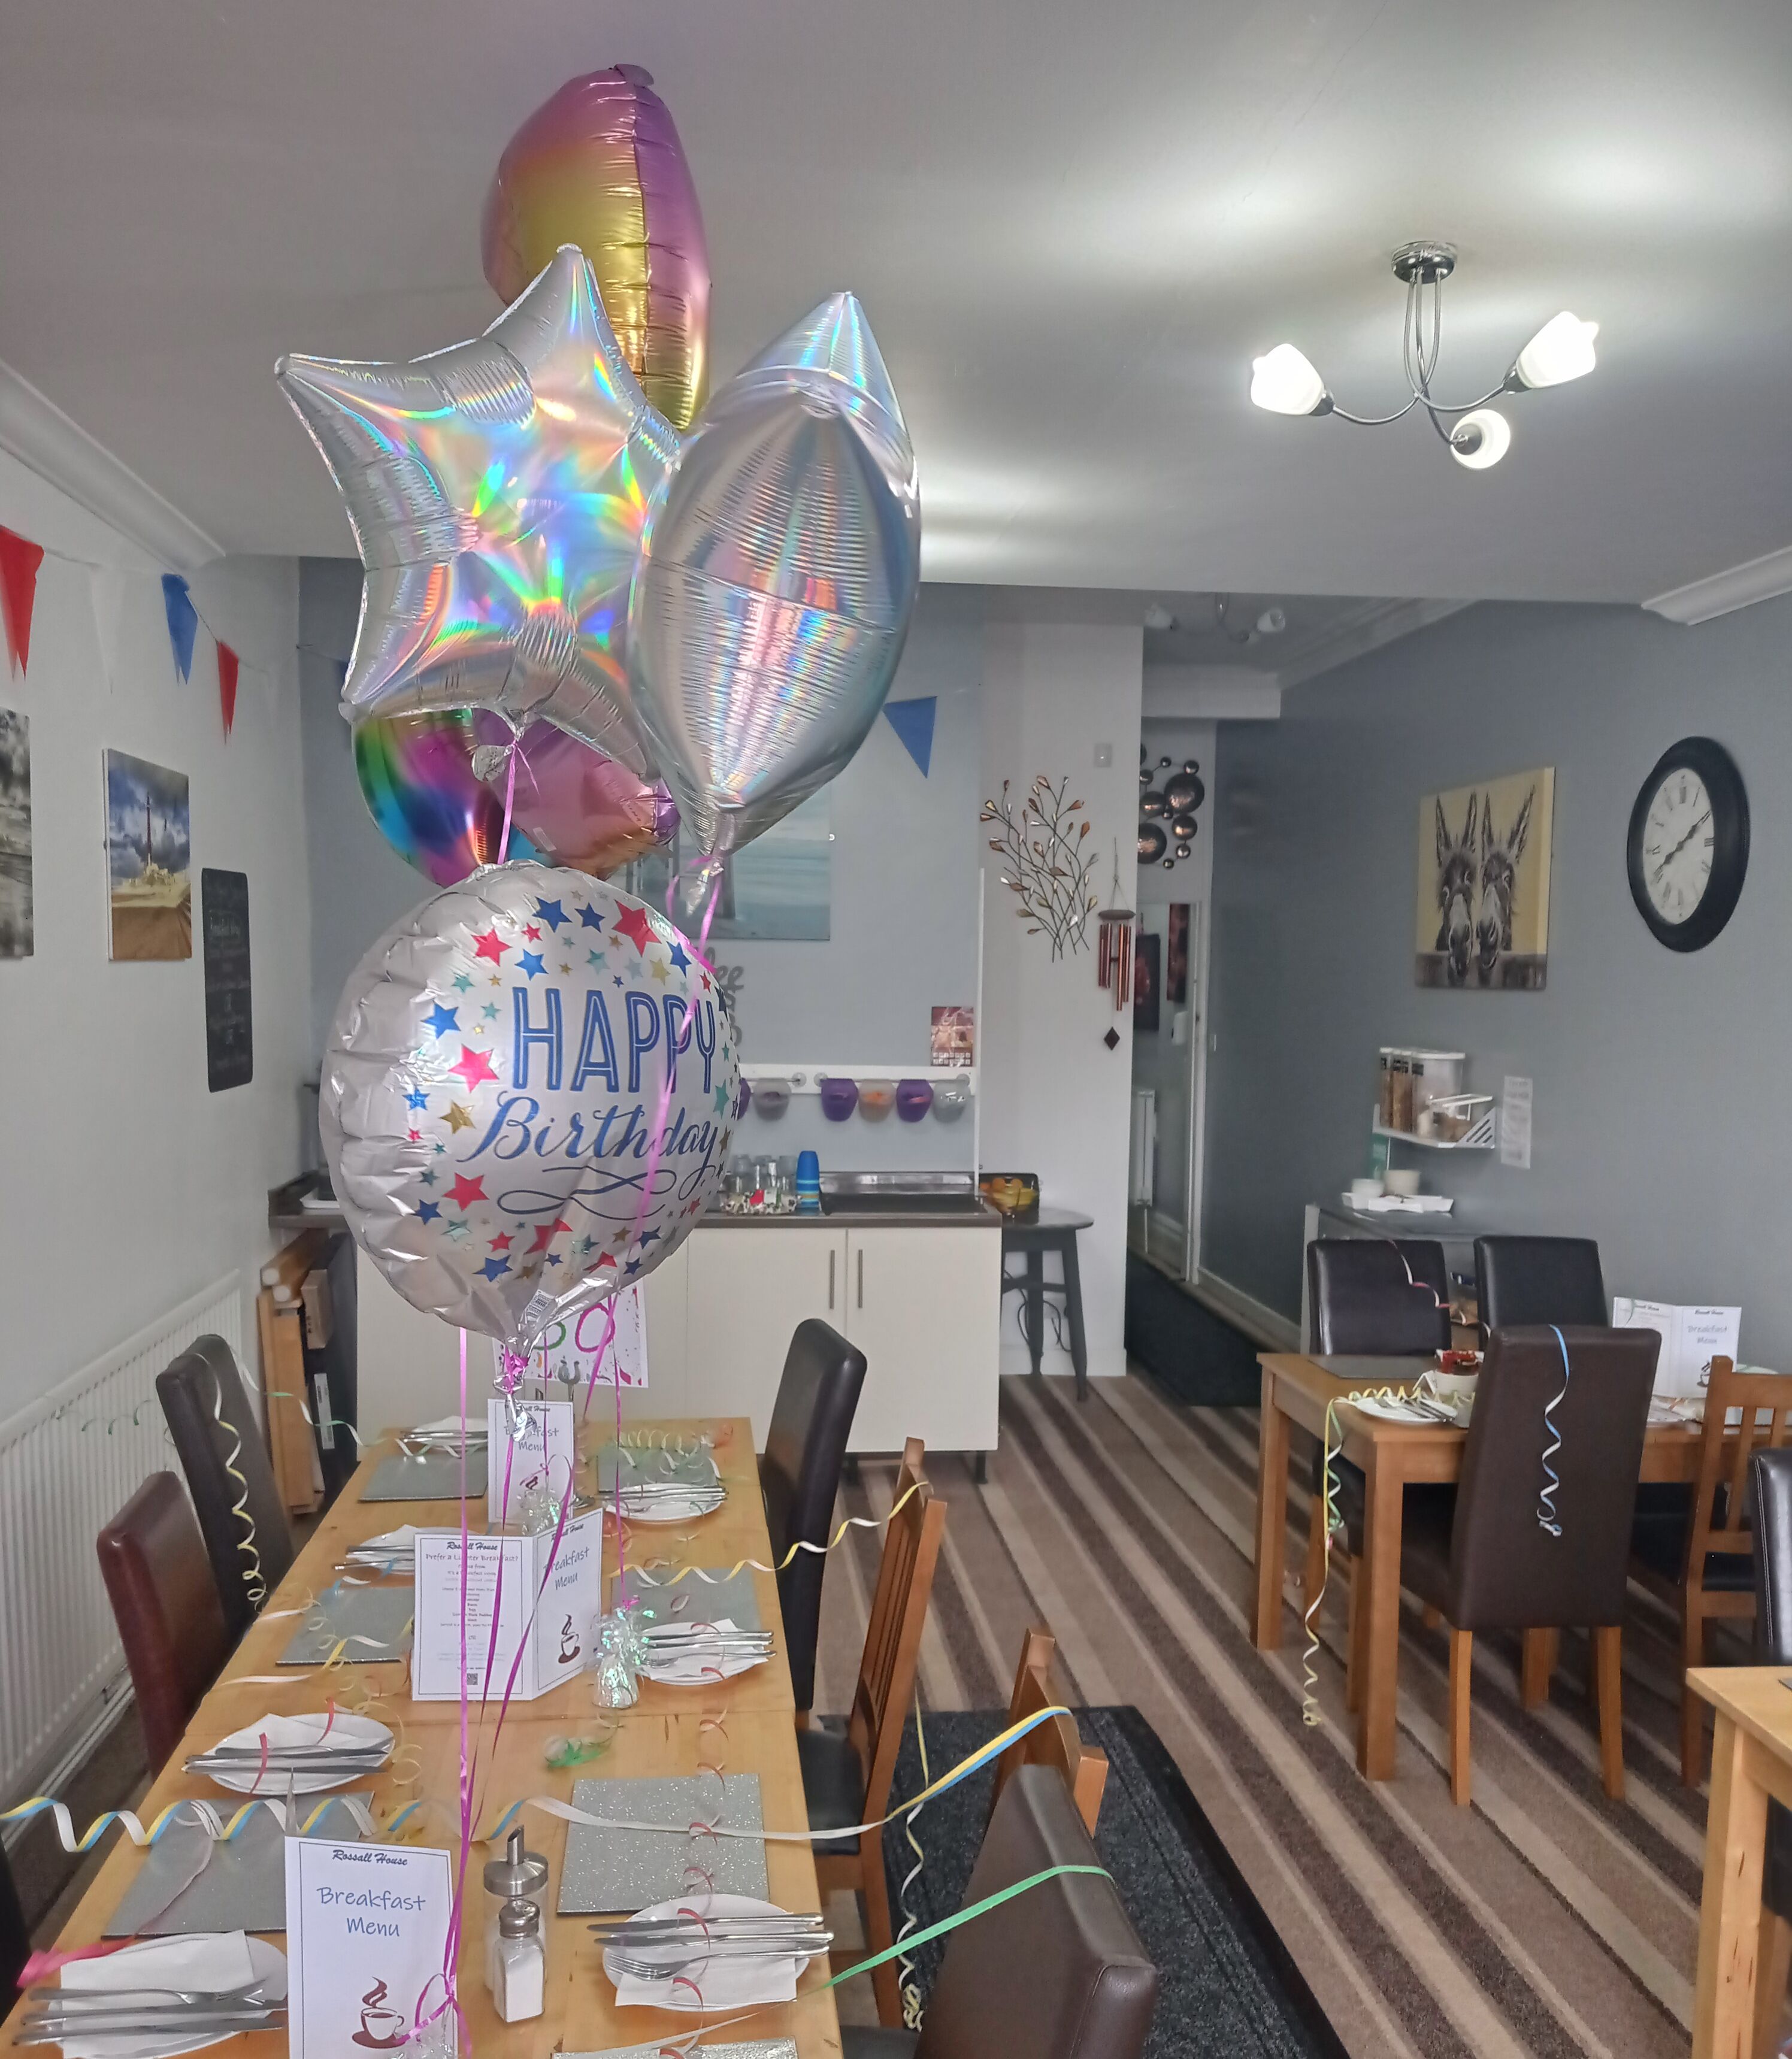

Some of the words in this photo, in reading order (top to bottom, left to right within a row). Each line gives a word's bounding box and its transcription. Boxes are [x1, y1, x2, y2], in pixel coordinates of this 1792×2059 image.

[511, 986, 716, 1094] HAPPY
[456, 1090, 718, 1200] Birthday
[475, 1542, 498, 1551] House
[425, 1553, 446, 1562] Prefer
[543, 1546, 590, 1573] reakfast
[555, 1572, 578, 1590] Menu
[332, 1849, 372, 1863] Rossall
[374, 1852, 408, 1866] House
[316, 1886, 426, 1911] Breakfast
[346, 1916, 400, 1937] Menu
